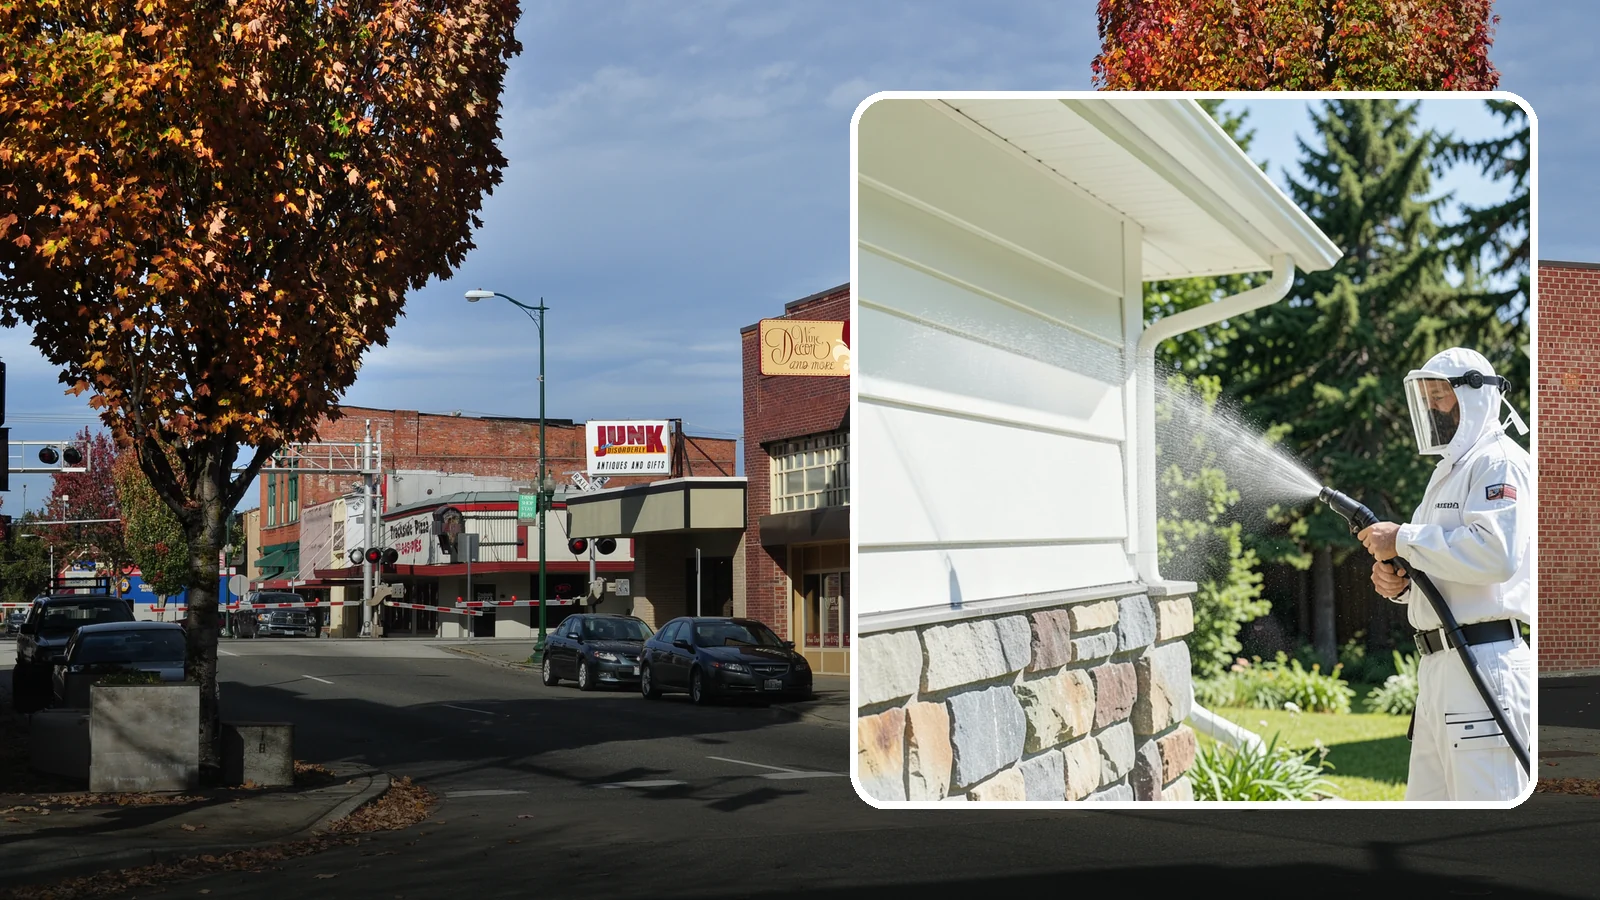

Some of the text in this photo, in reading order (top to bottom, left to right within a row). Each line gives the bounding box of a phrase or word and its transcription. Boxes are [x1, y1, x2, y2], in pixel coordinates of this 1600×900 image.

[596, 425, 665, 457] JUNK
[608, 446, 646, 454] DISORDERLY
[597, 460, 665, 470] ANTIQUES AND GIFTS
[573, 473, 588, 490] RAIL
[390, 519, 429, 539] Trackside Pizza
